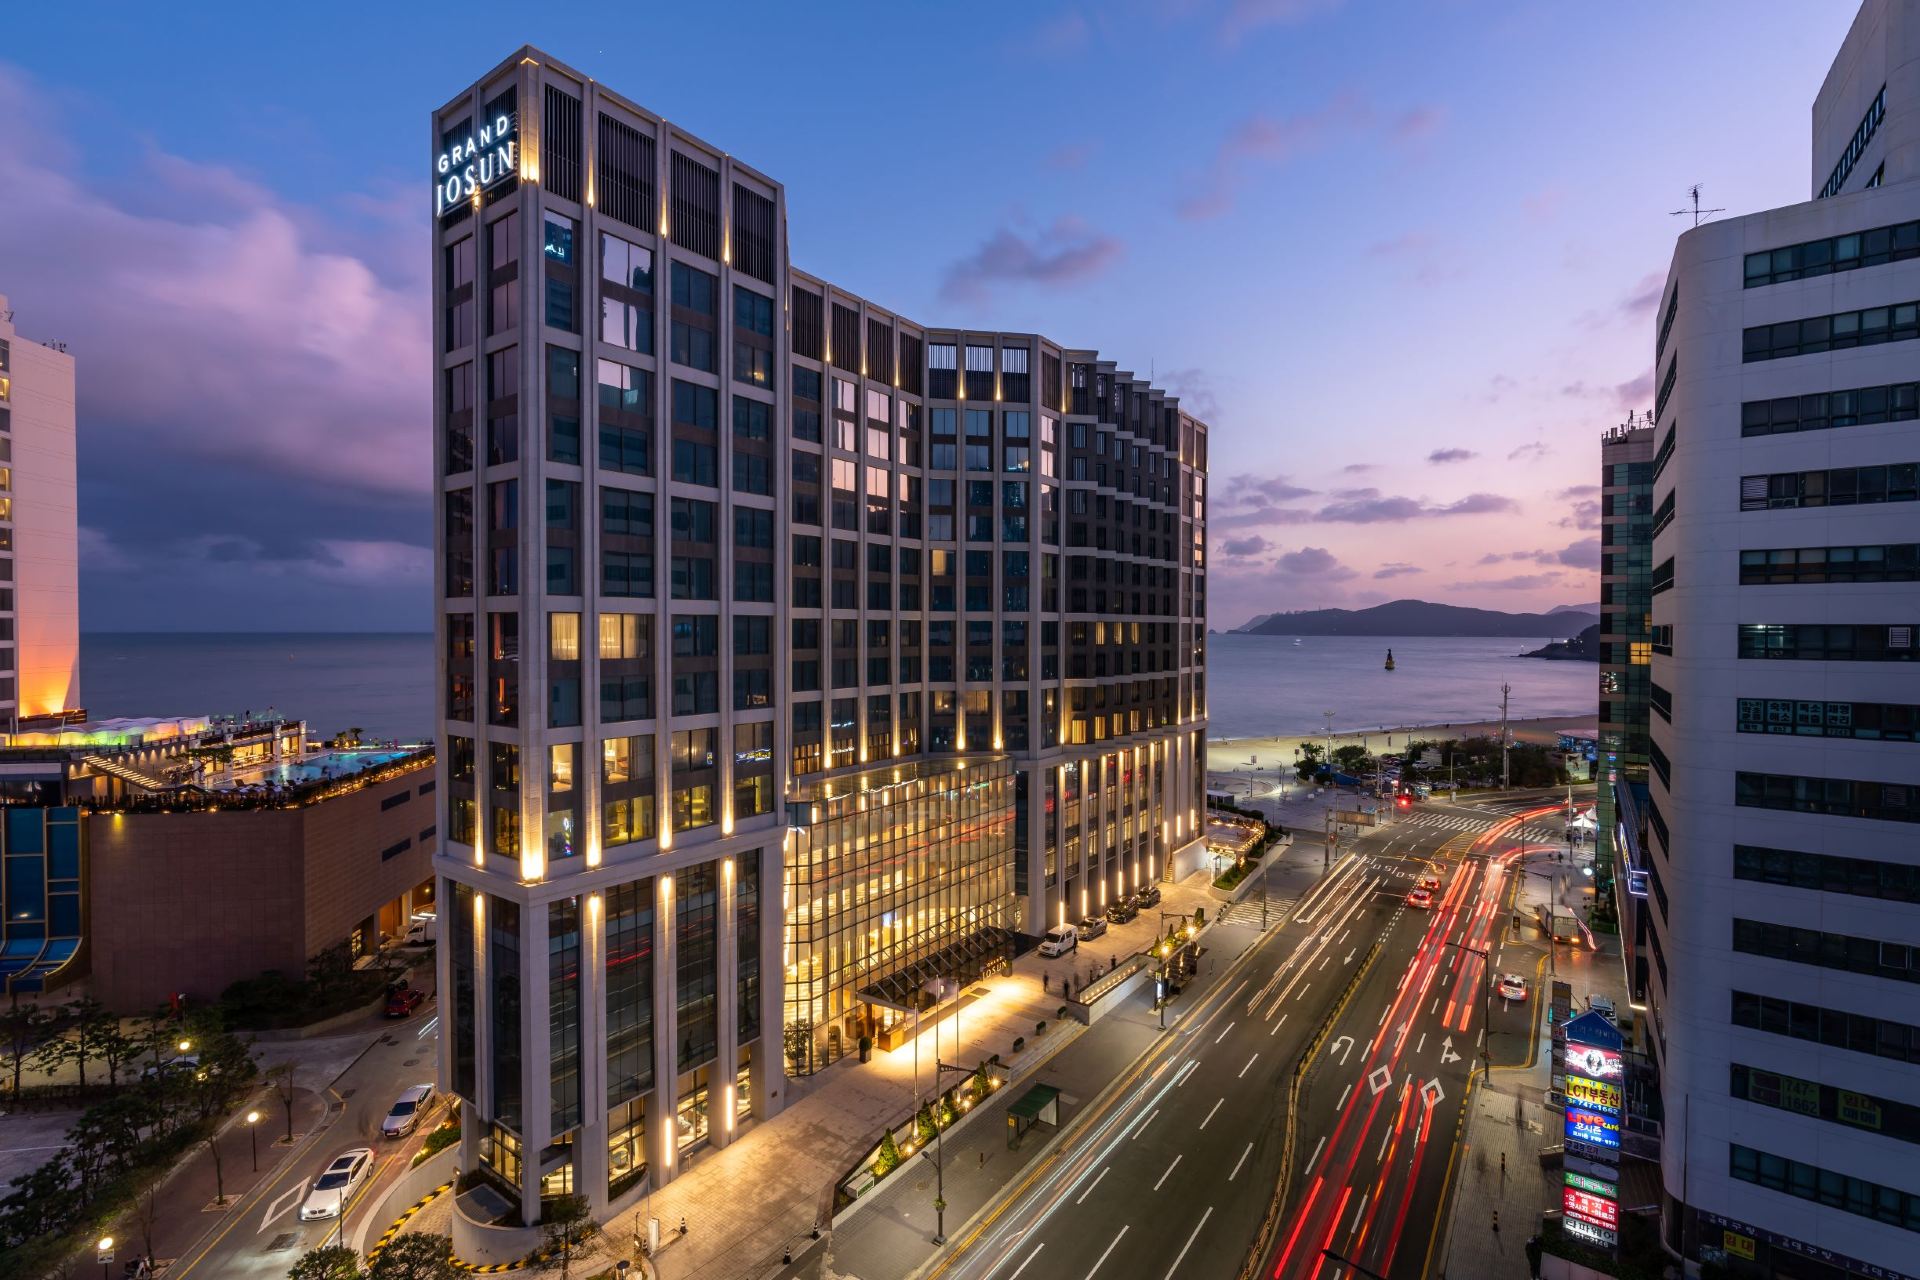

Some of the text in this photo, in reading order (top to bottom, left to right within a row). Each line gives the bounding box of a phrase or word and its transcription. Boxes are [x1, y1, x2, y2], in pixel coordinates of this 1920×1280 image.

[438, 115, 508, 173] GRAND
[437, 141, 515, 217] JOSUN
[1566, 1082, 1619, 1107] LCT부동산
